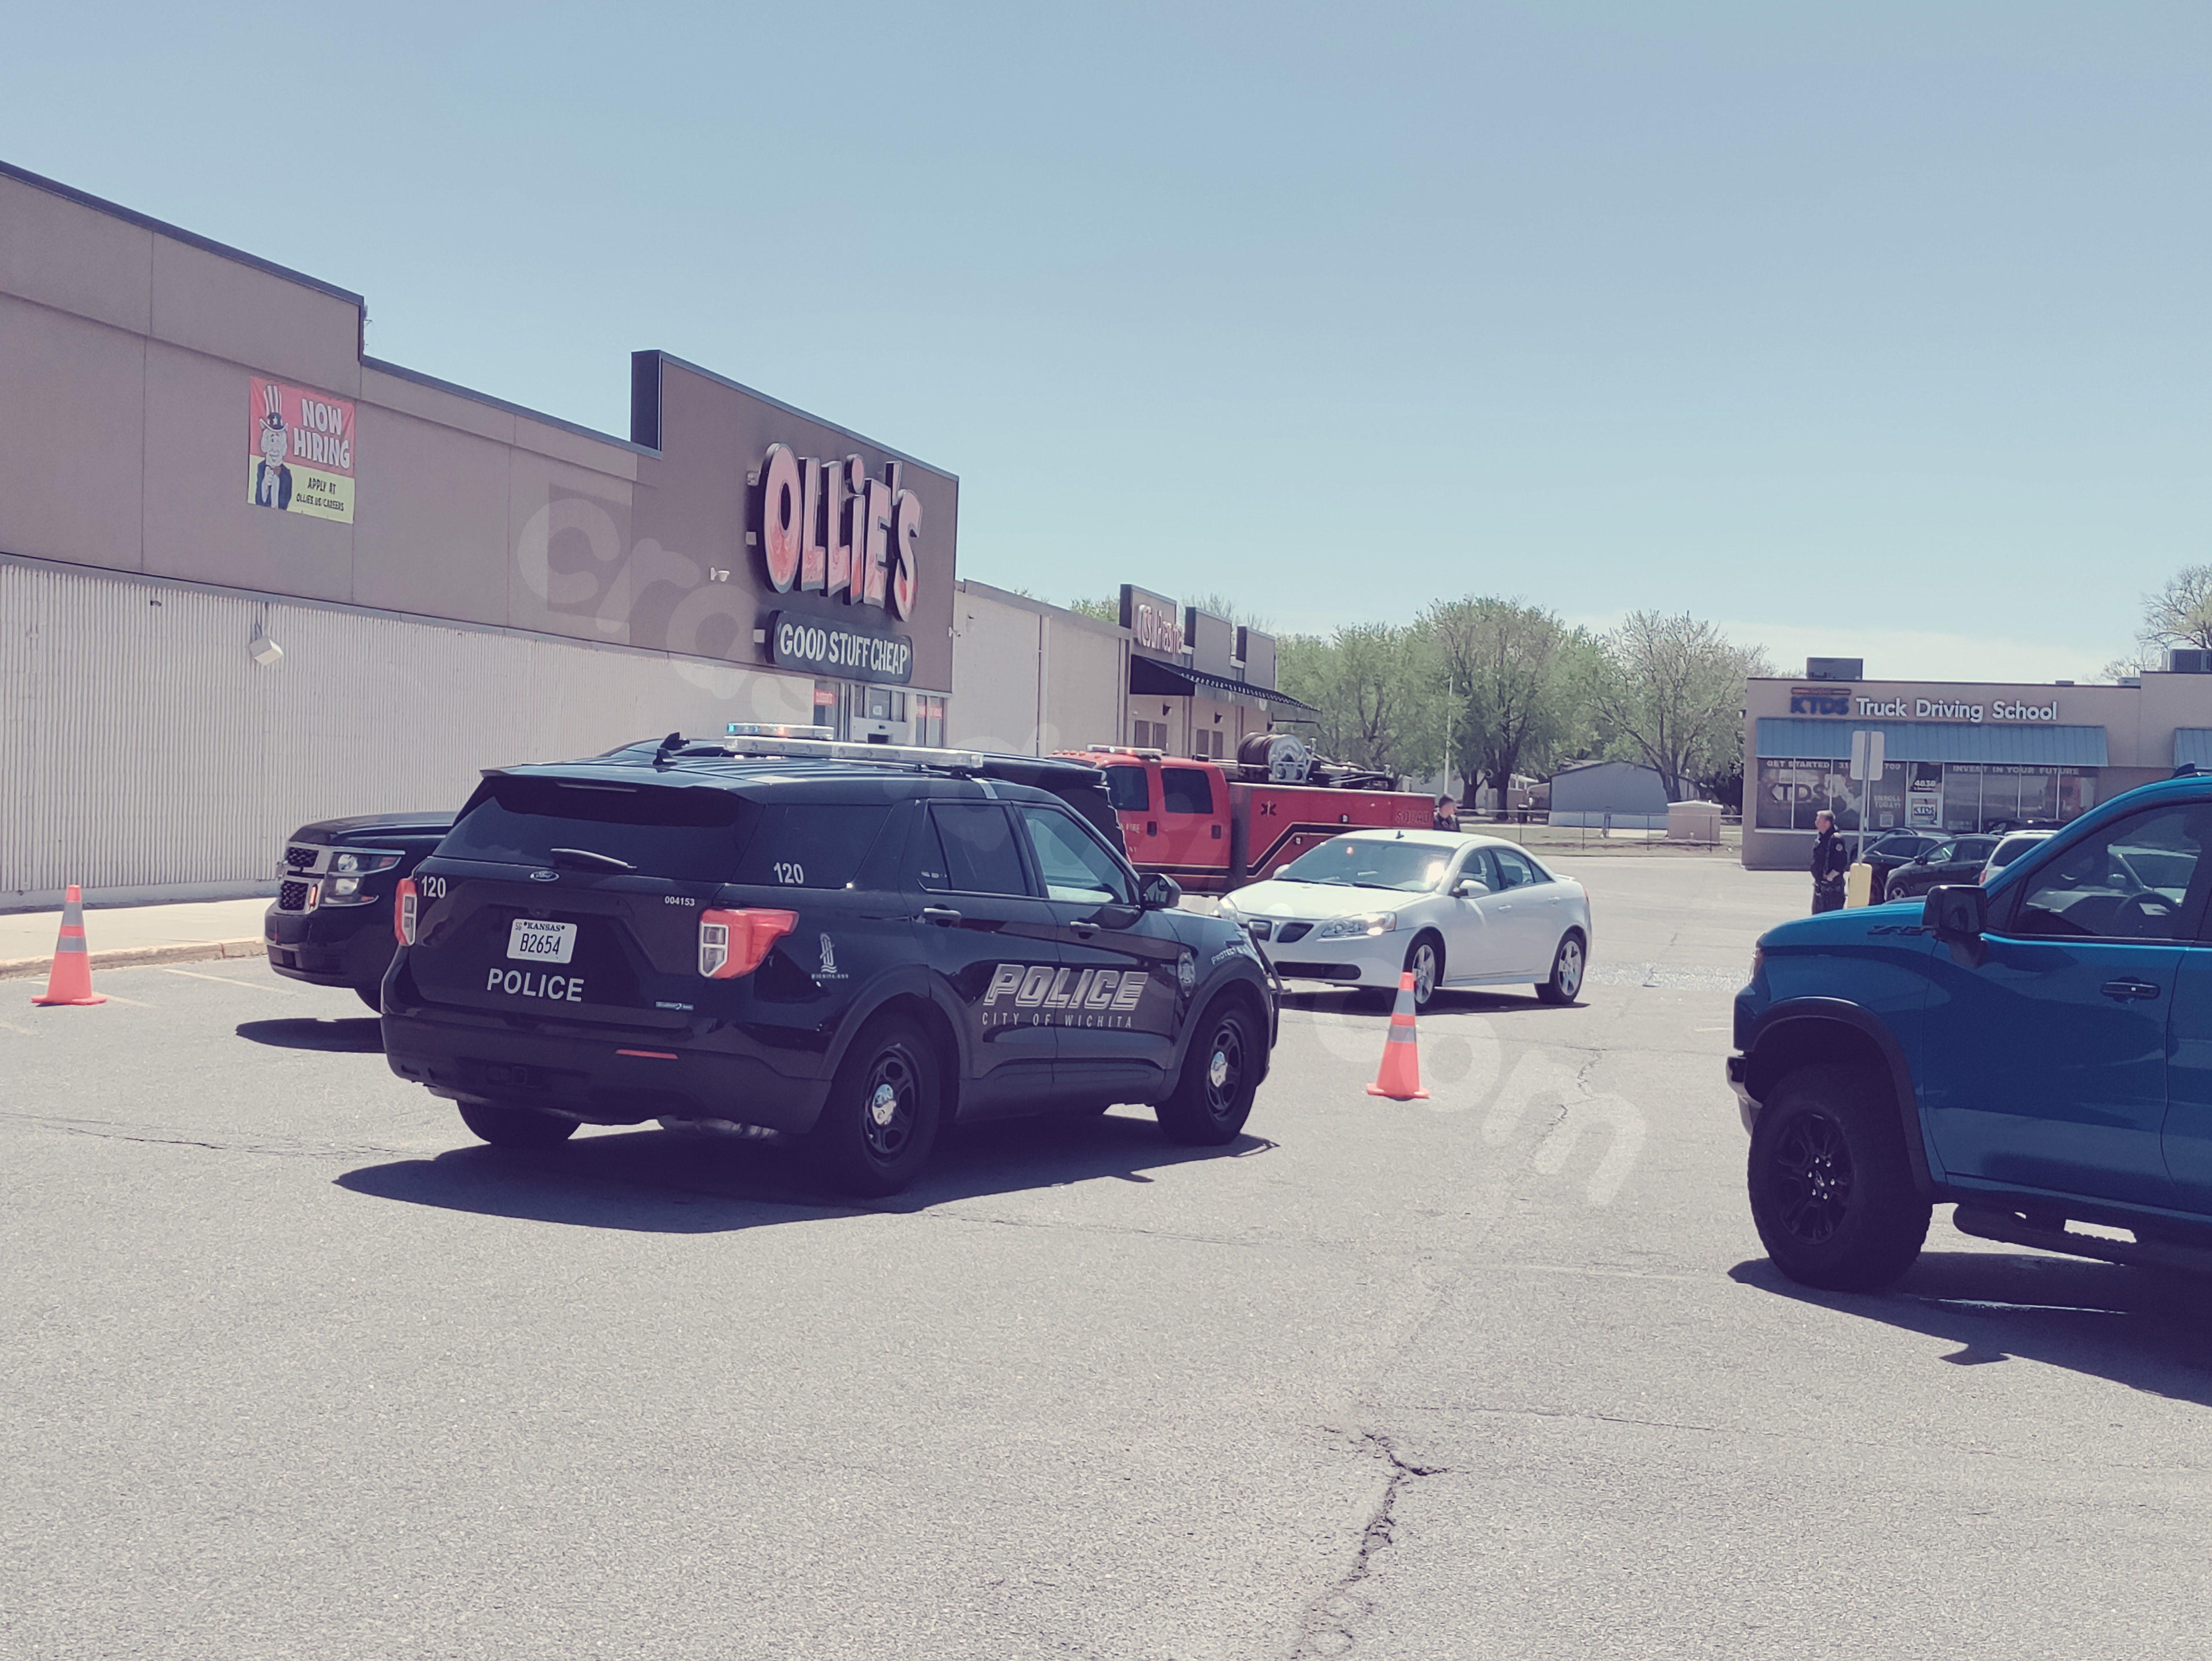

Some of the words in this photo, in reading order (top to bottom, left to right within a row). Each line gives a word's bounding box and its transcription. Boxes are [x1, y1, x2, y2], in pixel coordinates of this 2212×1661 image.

[302, 398, 342, 435] NOW
[293, 427, 350, 469] HIRING
[307, 477, 327, 492] APPLY
[329, 482, 336, 495] AT
[828, 631, 870, 667] STUFF
[871, 638, 908, 675] CHEAP
[1791, 697, 1849, 715] KTDS
[1856, 698, 1907, 717] Truck
[1916, 698, 1983, 723] Driving
[1992, 700, 2057, 720] School
[774, 862, 804, 884] 120
[421, 875, 446, 898] 120
[664, 896, 695, 906] 004153
[527, 922, 561, 932] KANSAS
[520, 933, 561, 955] B2654
[487, 968, 584, 1002] POLICE
[983, 963, 1149, 1010] POLICE
[982, 1012, 1019, 1025] CITY
[1033, 1013, 1051, 1026] OF
[1065, 1014, 1131, 1028] WICHITA
